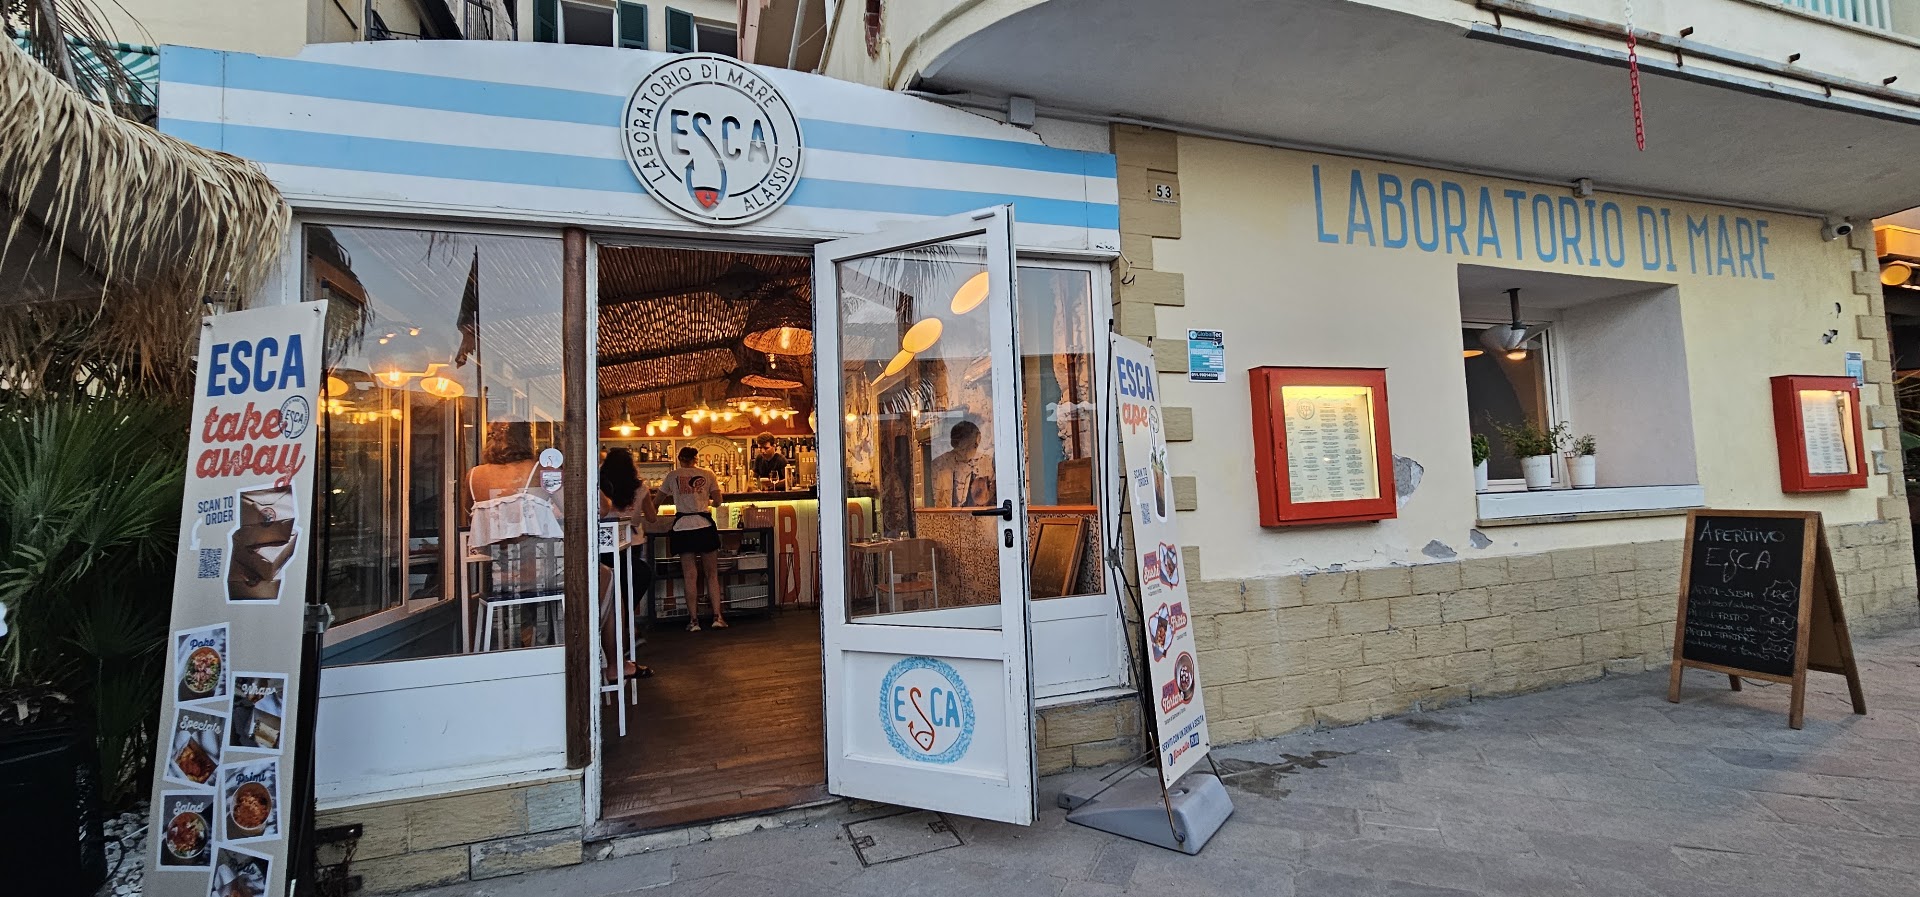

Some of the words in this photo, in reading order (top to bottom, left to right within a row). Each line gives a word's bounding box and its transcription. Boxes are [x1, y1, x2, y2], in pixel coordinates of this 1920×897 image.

[633, 66, 692, 183] LABORATORIO
[701, 64, 718, 79] DI
[728, 68, 778, 108] MARE
[670, 108, 770, 187] ESCA
[743, 156, 793, 212] ALASSIO
[1156, 185, 1172, 198] 53
[1312, 164, 1626, 269] LABORATORIO
[1636, 205, 1678, 272] DI
[1687, 213, 1776, 280] MARE
[206, 333, 306, 397] ESCA
[1116, 355, 1155, 401] ESCA
[201, 401, 284, 444] take
[196, 443, 306, 488] away
[197, 497, 221, 514] SCAN
[223, 496, 234, 509] TO
[206, 510, 234, 526] ORDER
[1706, 548, 1771, 580] ESCA
[190, 638, 216, 650] Poke
[241, 682, 278, 696] Wraps
[179, 714, 223, 736] Specials
[894, 686, 960, 740] ESCA
[173, 800, 205, 816] Salad
